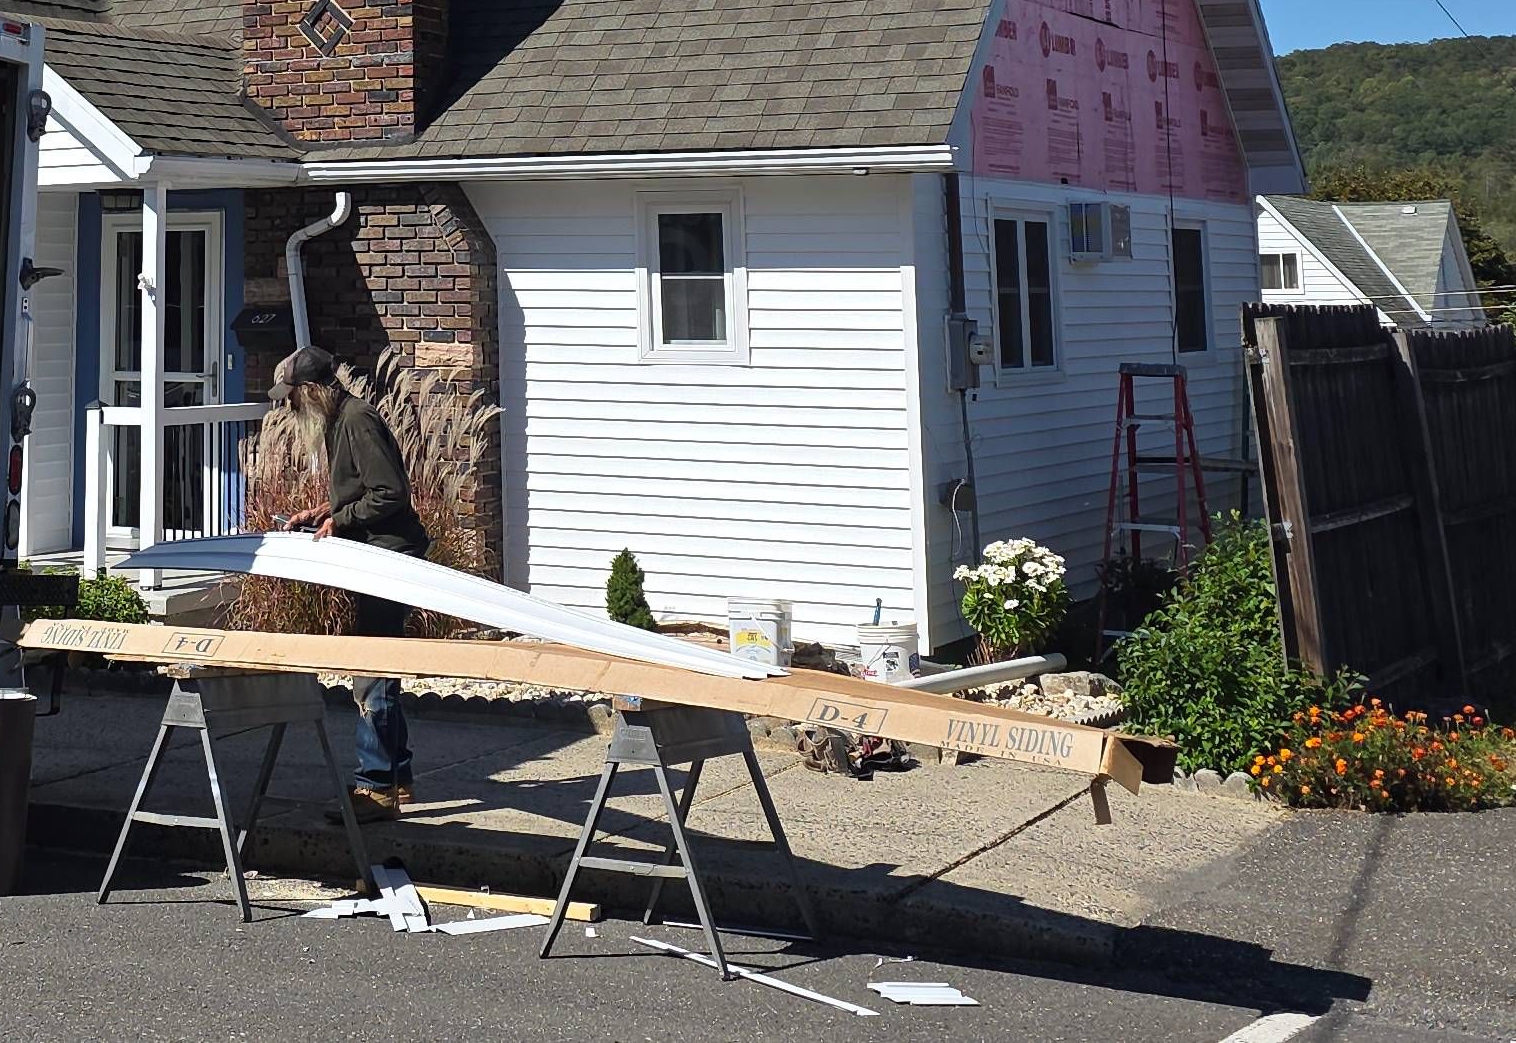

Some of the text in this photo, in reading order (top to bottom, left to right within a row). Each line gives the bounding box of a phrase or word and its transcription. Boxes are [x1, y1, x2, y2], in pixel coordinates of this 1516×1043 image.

[252, 313, 276, 324] 627
[40, 625, 128, 649] VINYL SIDING
[175, 636, 215, 653] D-4
[817, 704, 868, 729] D-4
[947, 718, 1074, 758] VINYL SIDING
